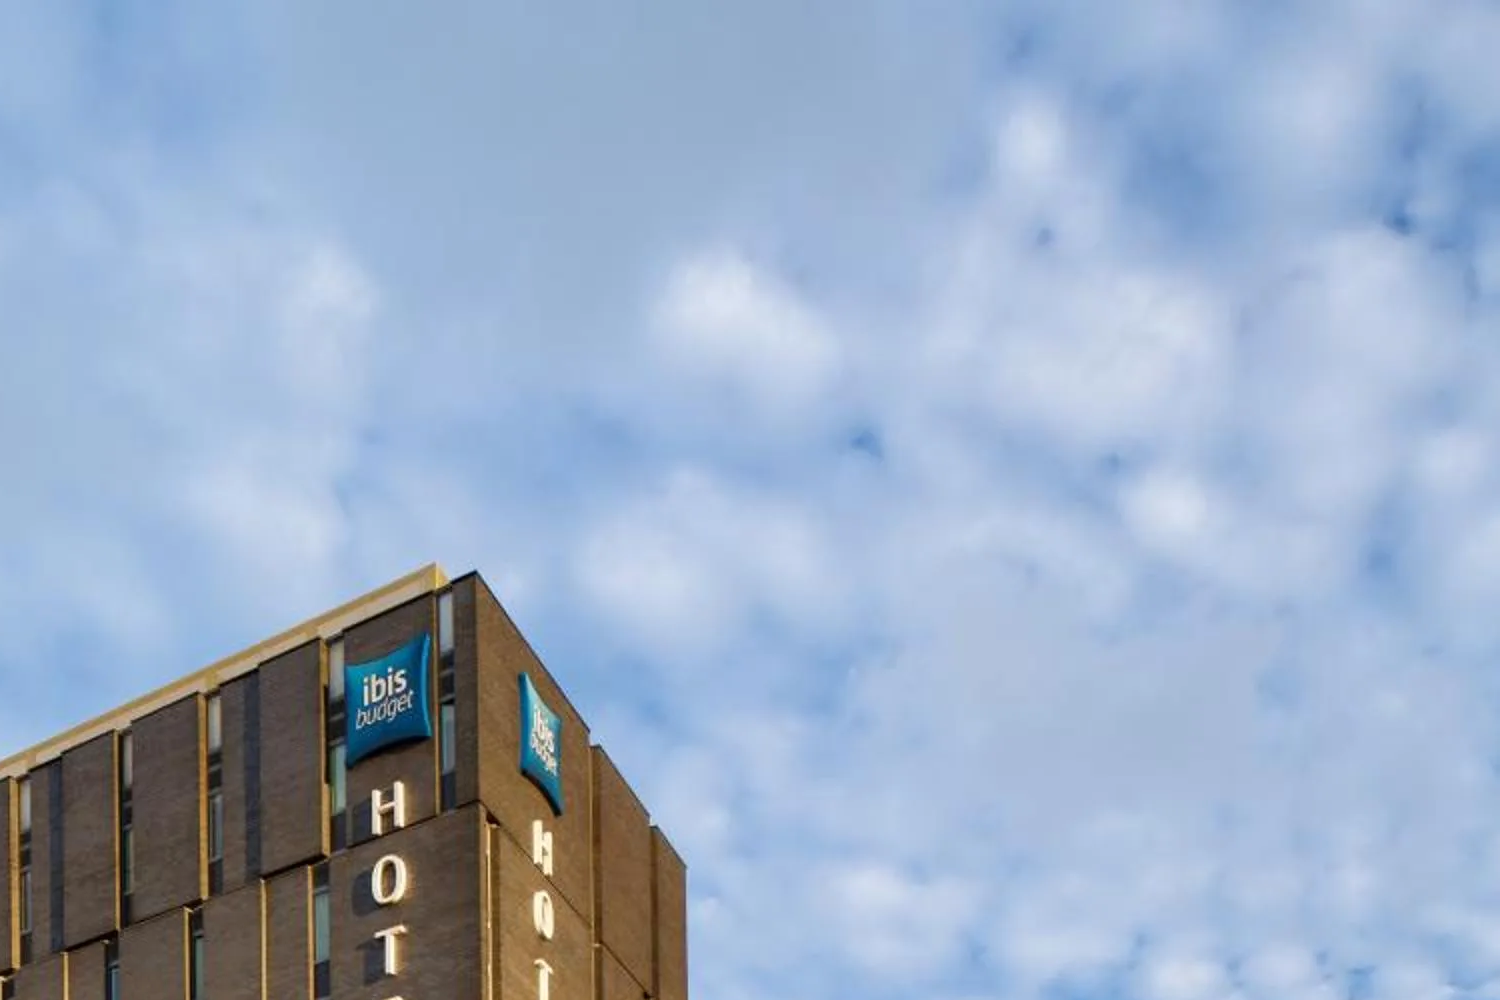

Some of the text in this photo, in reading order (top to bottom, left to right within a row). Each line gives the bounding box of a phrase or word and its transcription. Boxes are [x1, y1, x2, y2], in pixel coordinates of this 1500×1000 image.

[363, 666, 407, 706] ibis
[355, 689, 414, 730] budget
[533, 702, 555, 753] ibis
[531, 731, 557, 777] budget
